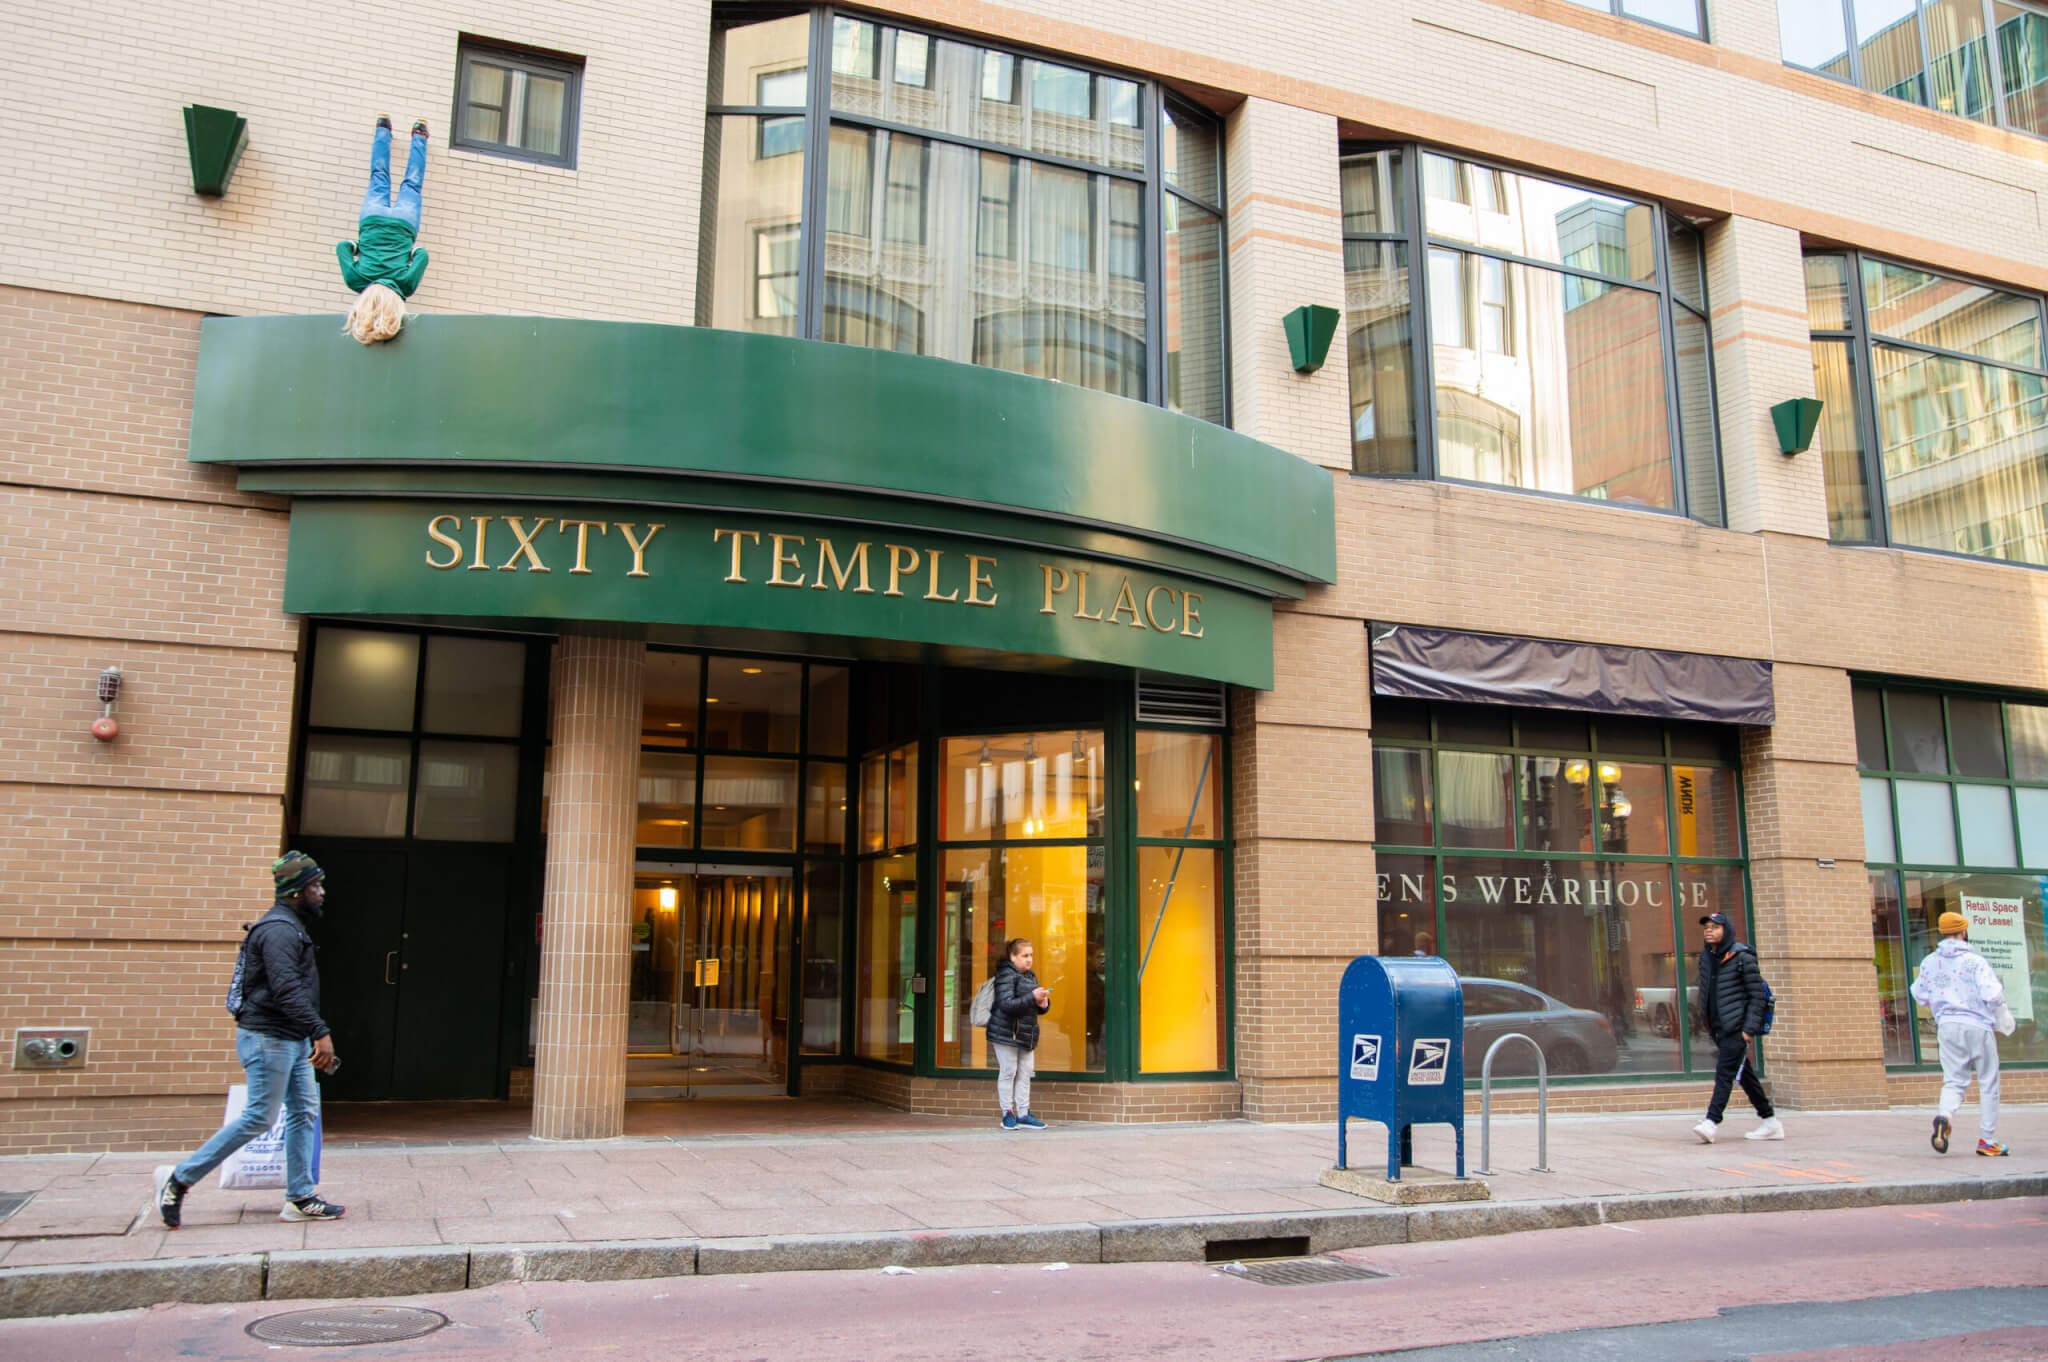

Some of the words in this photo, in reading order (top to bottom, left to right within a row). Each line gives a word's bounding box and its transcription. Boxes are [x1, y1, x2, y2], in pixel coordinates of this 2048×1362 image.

[426, 514, 666, 577] SIXTY
[713, 528, 998, 607] TEMPLE
[1039, 564, 1204, 638] PLACE
[1965, 900, 1990, 911] Retail
[1992, 902, 2019, 914] Space
[1973, 915, 1987, 926] For
